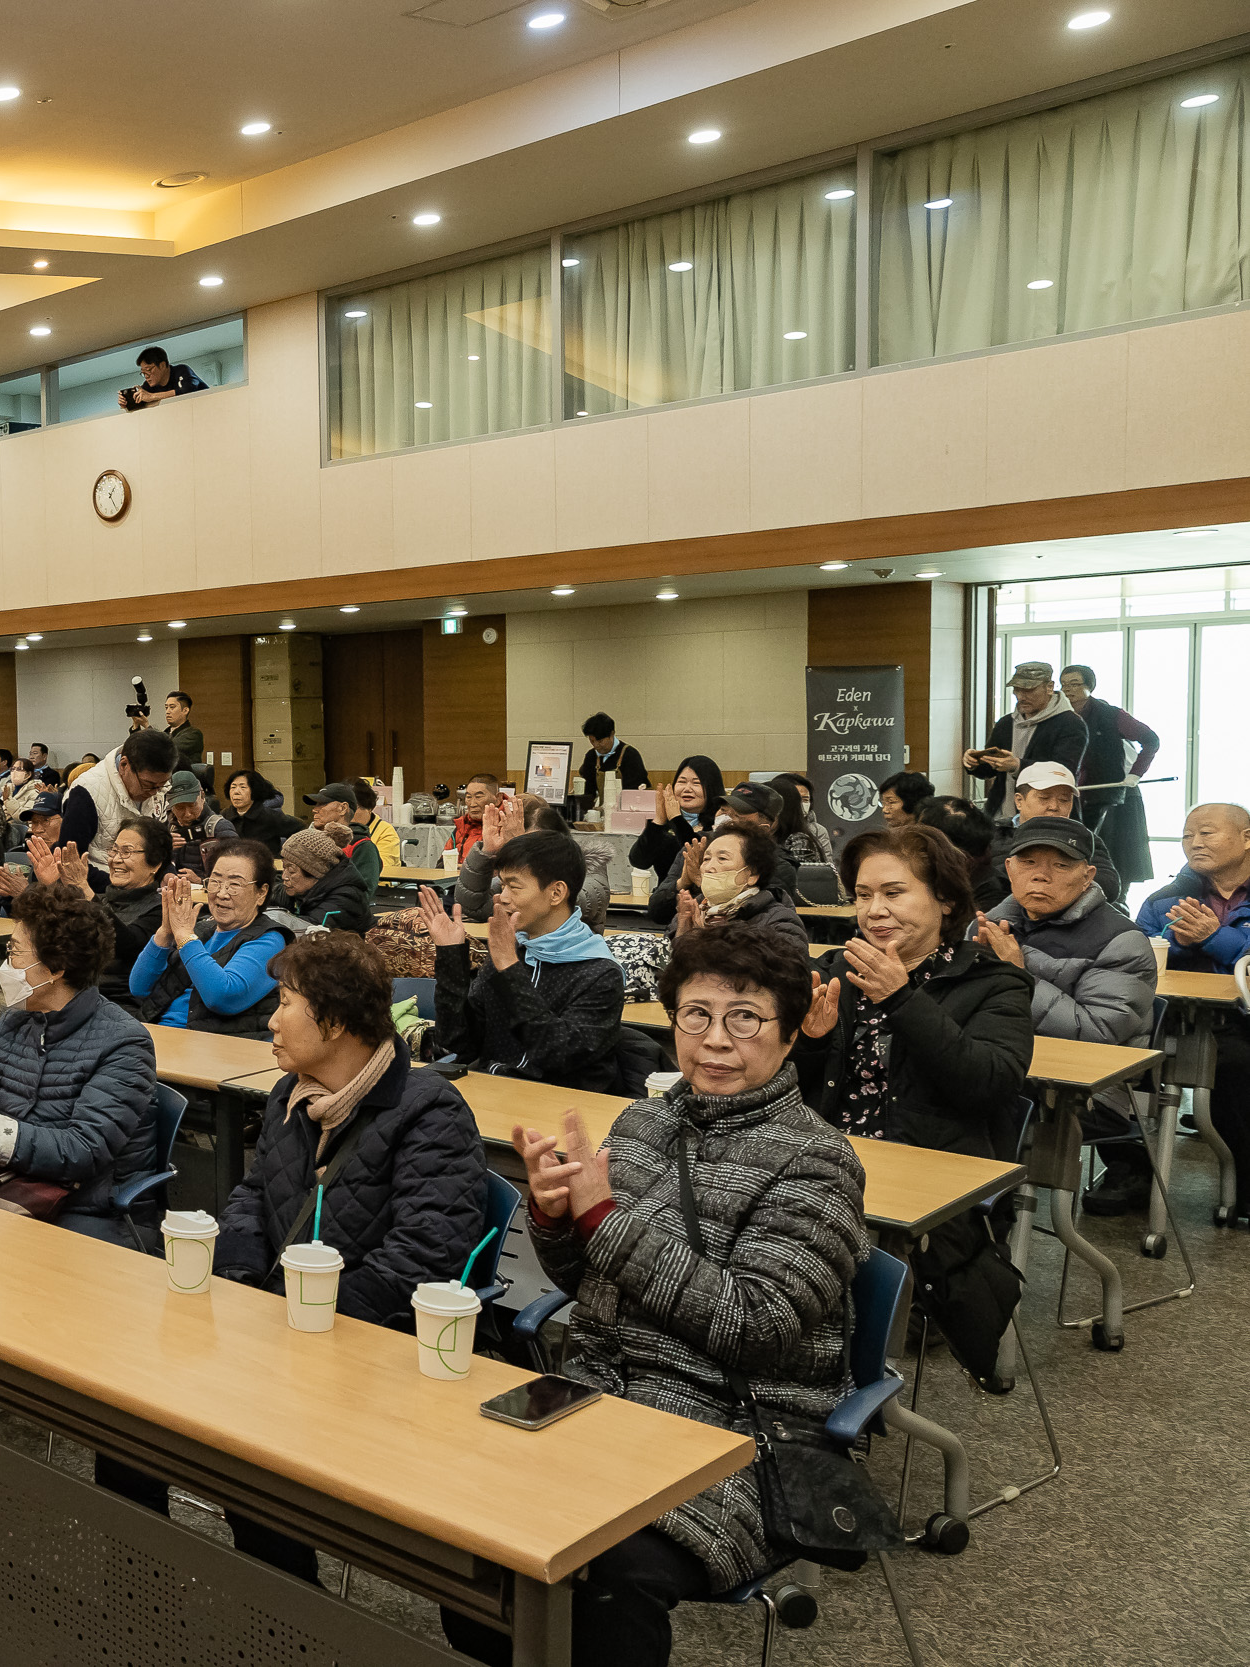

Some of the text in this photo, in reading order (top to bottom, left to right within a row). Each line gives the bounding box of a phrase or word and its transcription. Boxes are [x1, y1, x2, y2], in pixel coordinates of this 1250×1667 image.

[836, 687, 872, 702] Eden
[813, 712, 895, 735] Kapkawa
[863, 744, 878, 753] 기상
[818, 754, 848, 762] 아프리카
